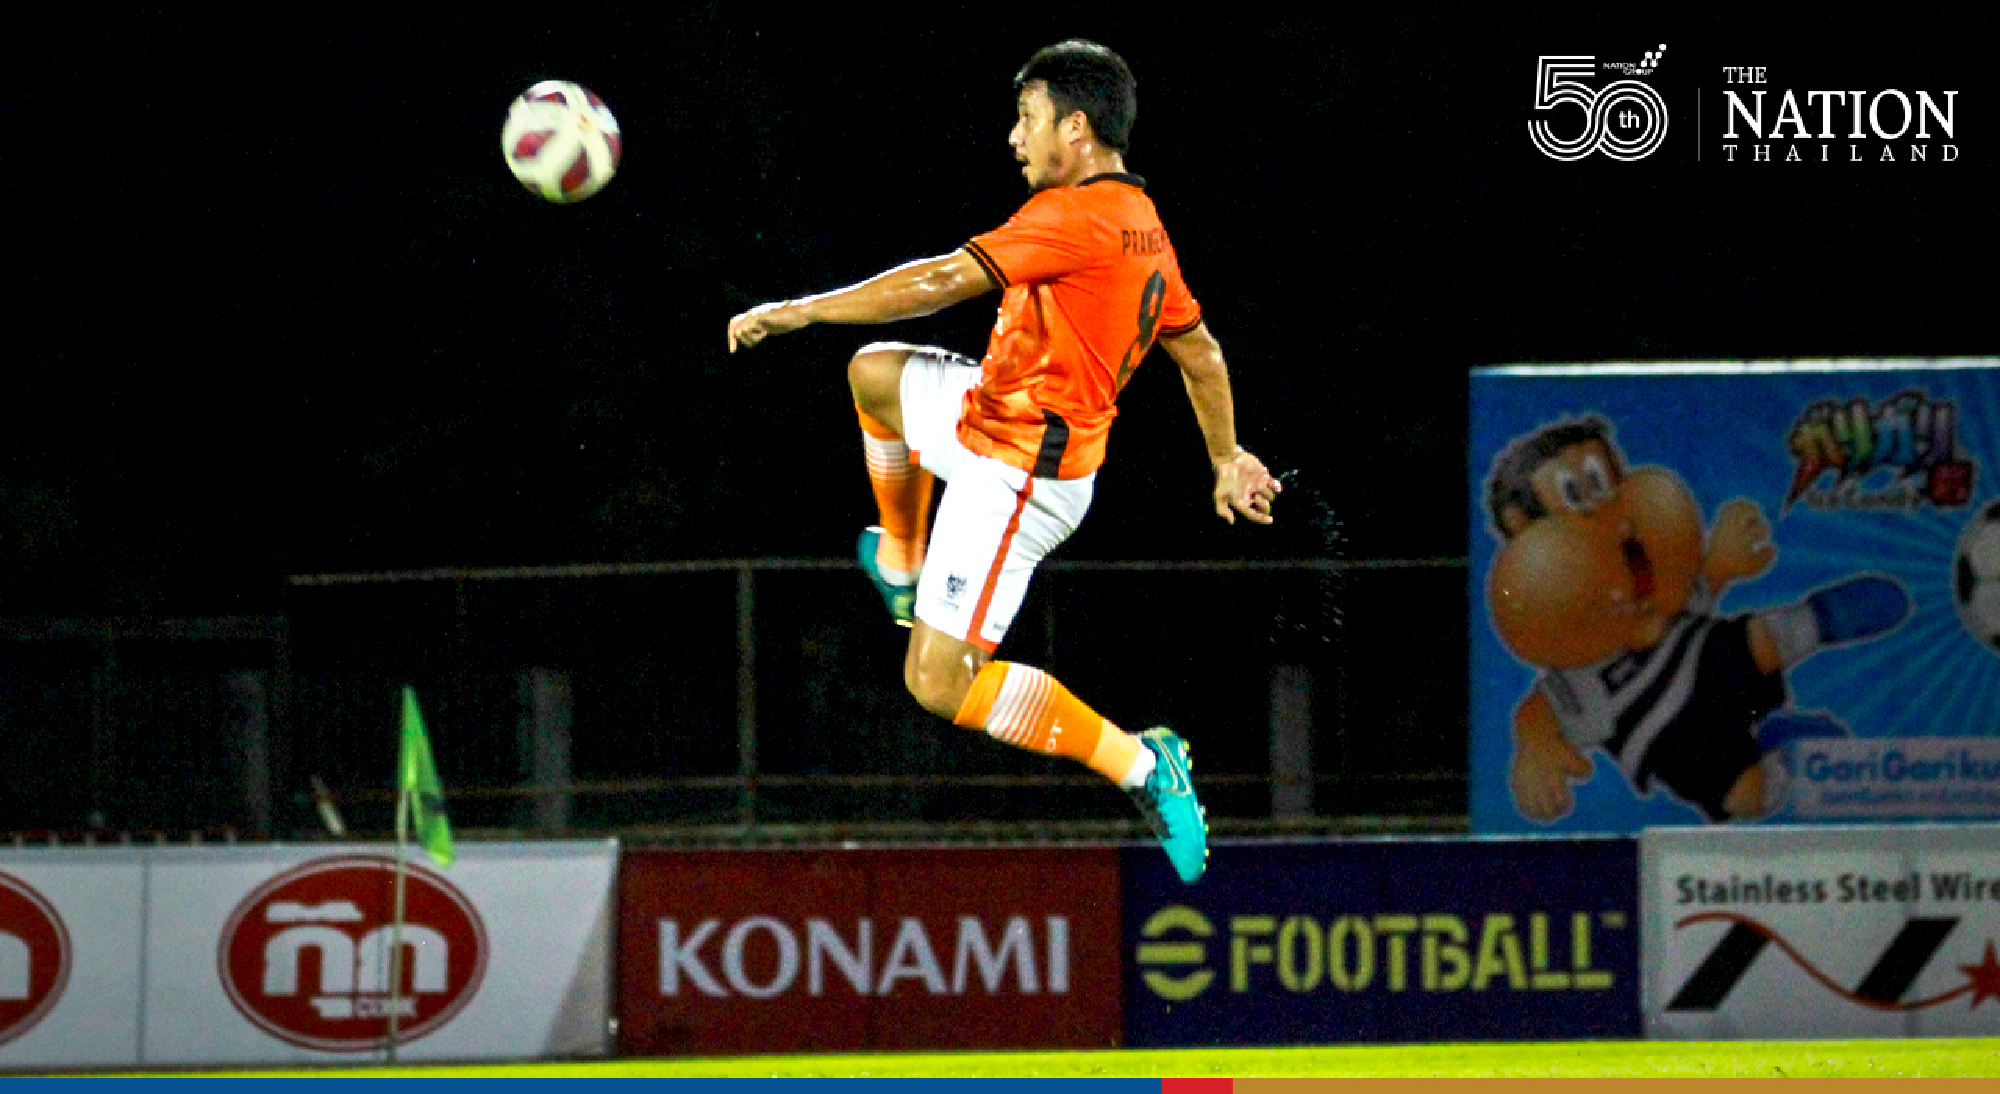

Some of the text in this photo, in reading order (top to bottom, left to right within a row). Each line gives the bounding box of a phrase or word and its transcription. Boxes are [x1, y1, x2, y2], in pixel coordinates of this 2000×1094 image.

[1677, 874, 1827, 902] Stainless
[1837, 872, 1920, 901] Steel
[659, 915, 1069, 998] KONAMI
